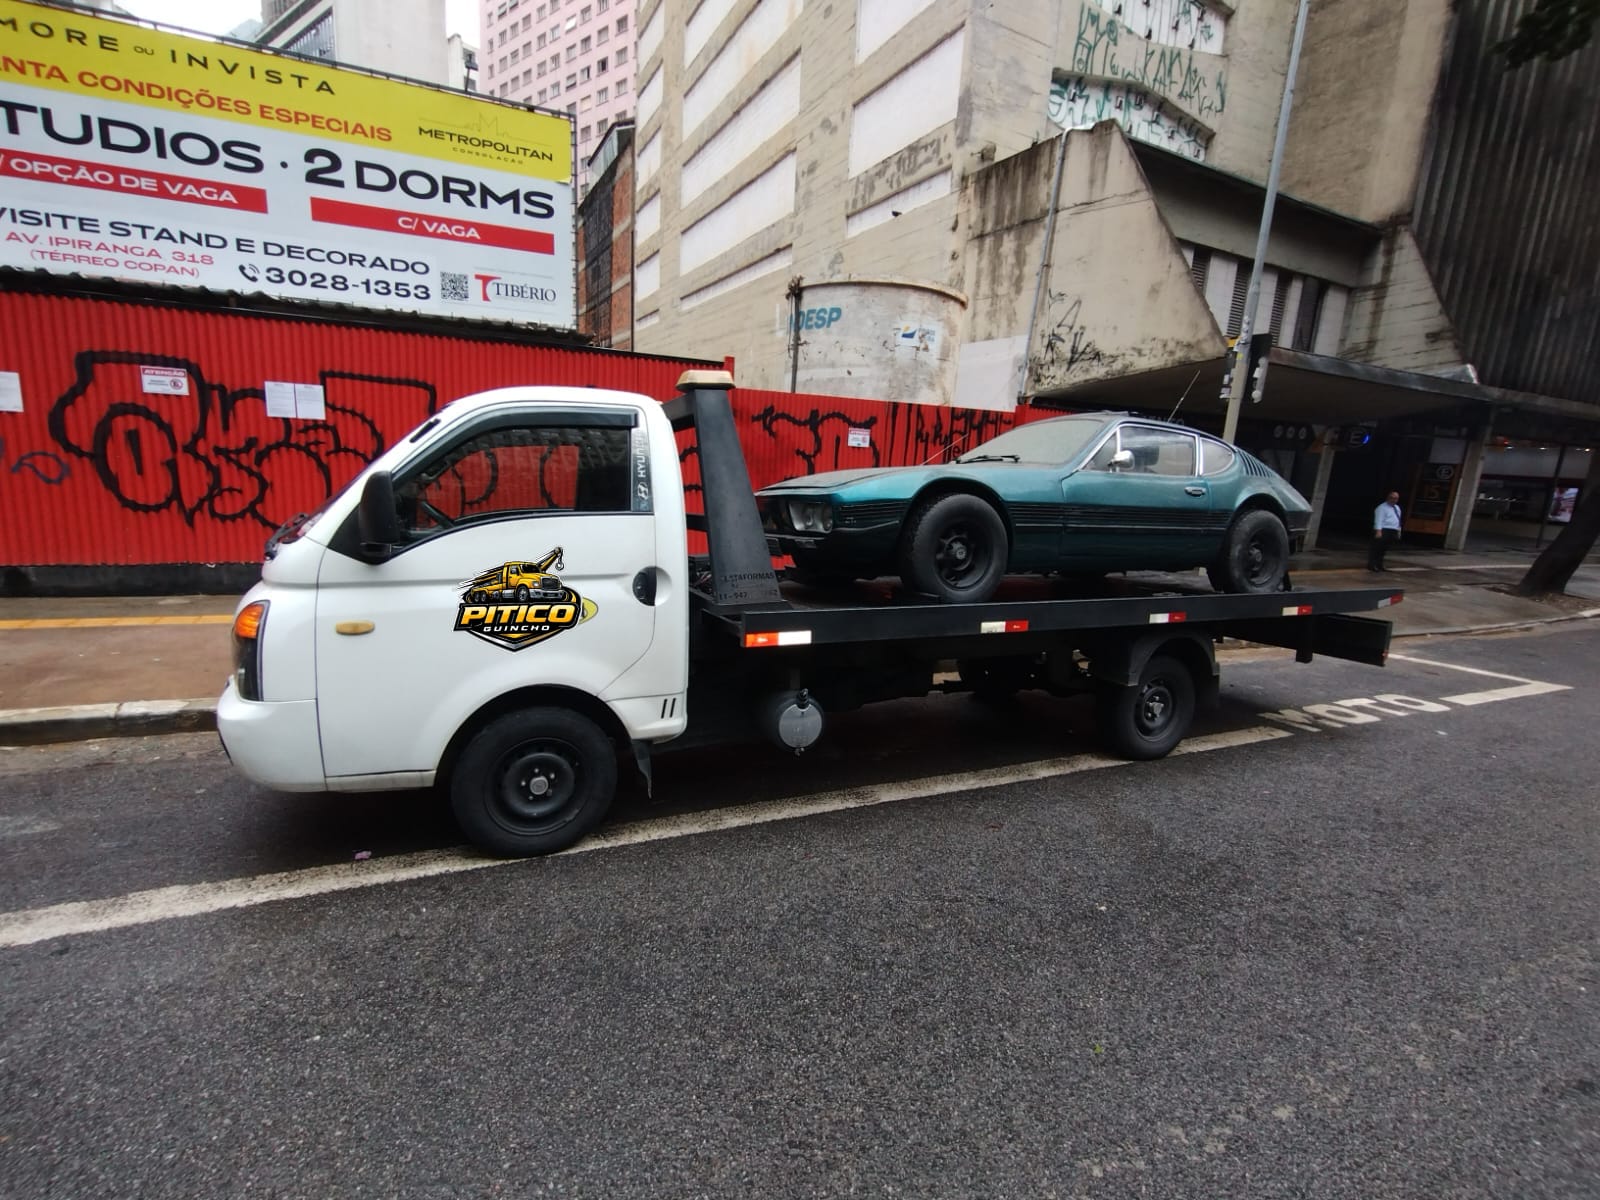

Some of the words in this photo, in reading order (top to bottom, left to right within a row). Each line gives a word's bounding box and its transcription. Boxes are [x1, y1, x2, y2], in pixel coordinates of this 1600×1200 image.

[133, 45, 155, 56] OU
[170, 49, 335, 95] INVISTA
[0, 55, 69, 83] NTA
[77, 71, 252, 115] CONDIÇÕES
[259, 105, 392, 142] ESPECIAIS
[418, 126, 553, 162] METROPOLITAN
[10, 157, 114, 185] OPÇÃO
[119, 174, 158, 191] DE
[163, 180, 238, 204] VAGA
[304, 148, 345, 189] 2
[355, 160, 555, 219] DORMS
[397, 216, 418, 231] C/
[422, 219, 481, 240] VAGA
[31, 248, 120, 268] (TÉRREO
[124, 259, 200, 279] COPAN)
[49, 236, 162, 259] IPIRANGA
[172, 251, 214, 266] 318
[109, 221, 228, 249] STAND
[236, 238, 255, 254] E
[263, 241, 430, 275] DECORADO
[266, 267, 431, 300] 3028-1353
[492, 281, 557, 302] TIBÉRIO
[460, 604, 576, 625] PITICO
[1257, 693, 1451, 732] MOTO
